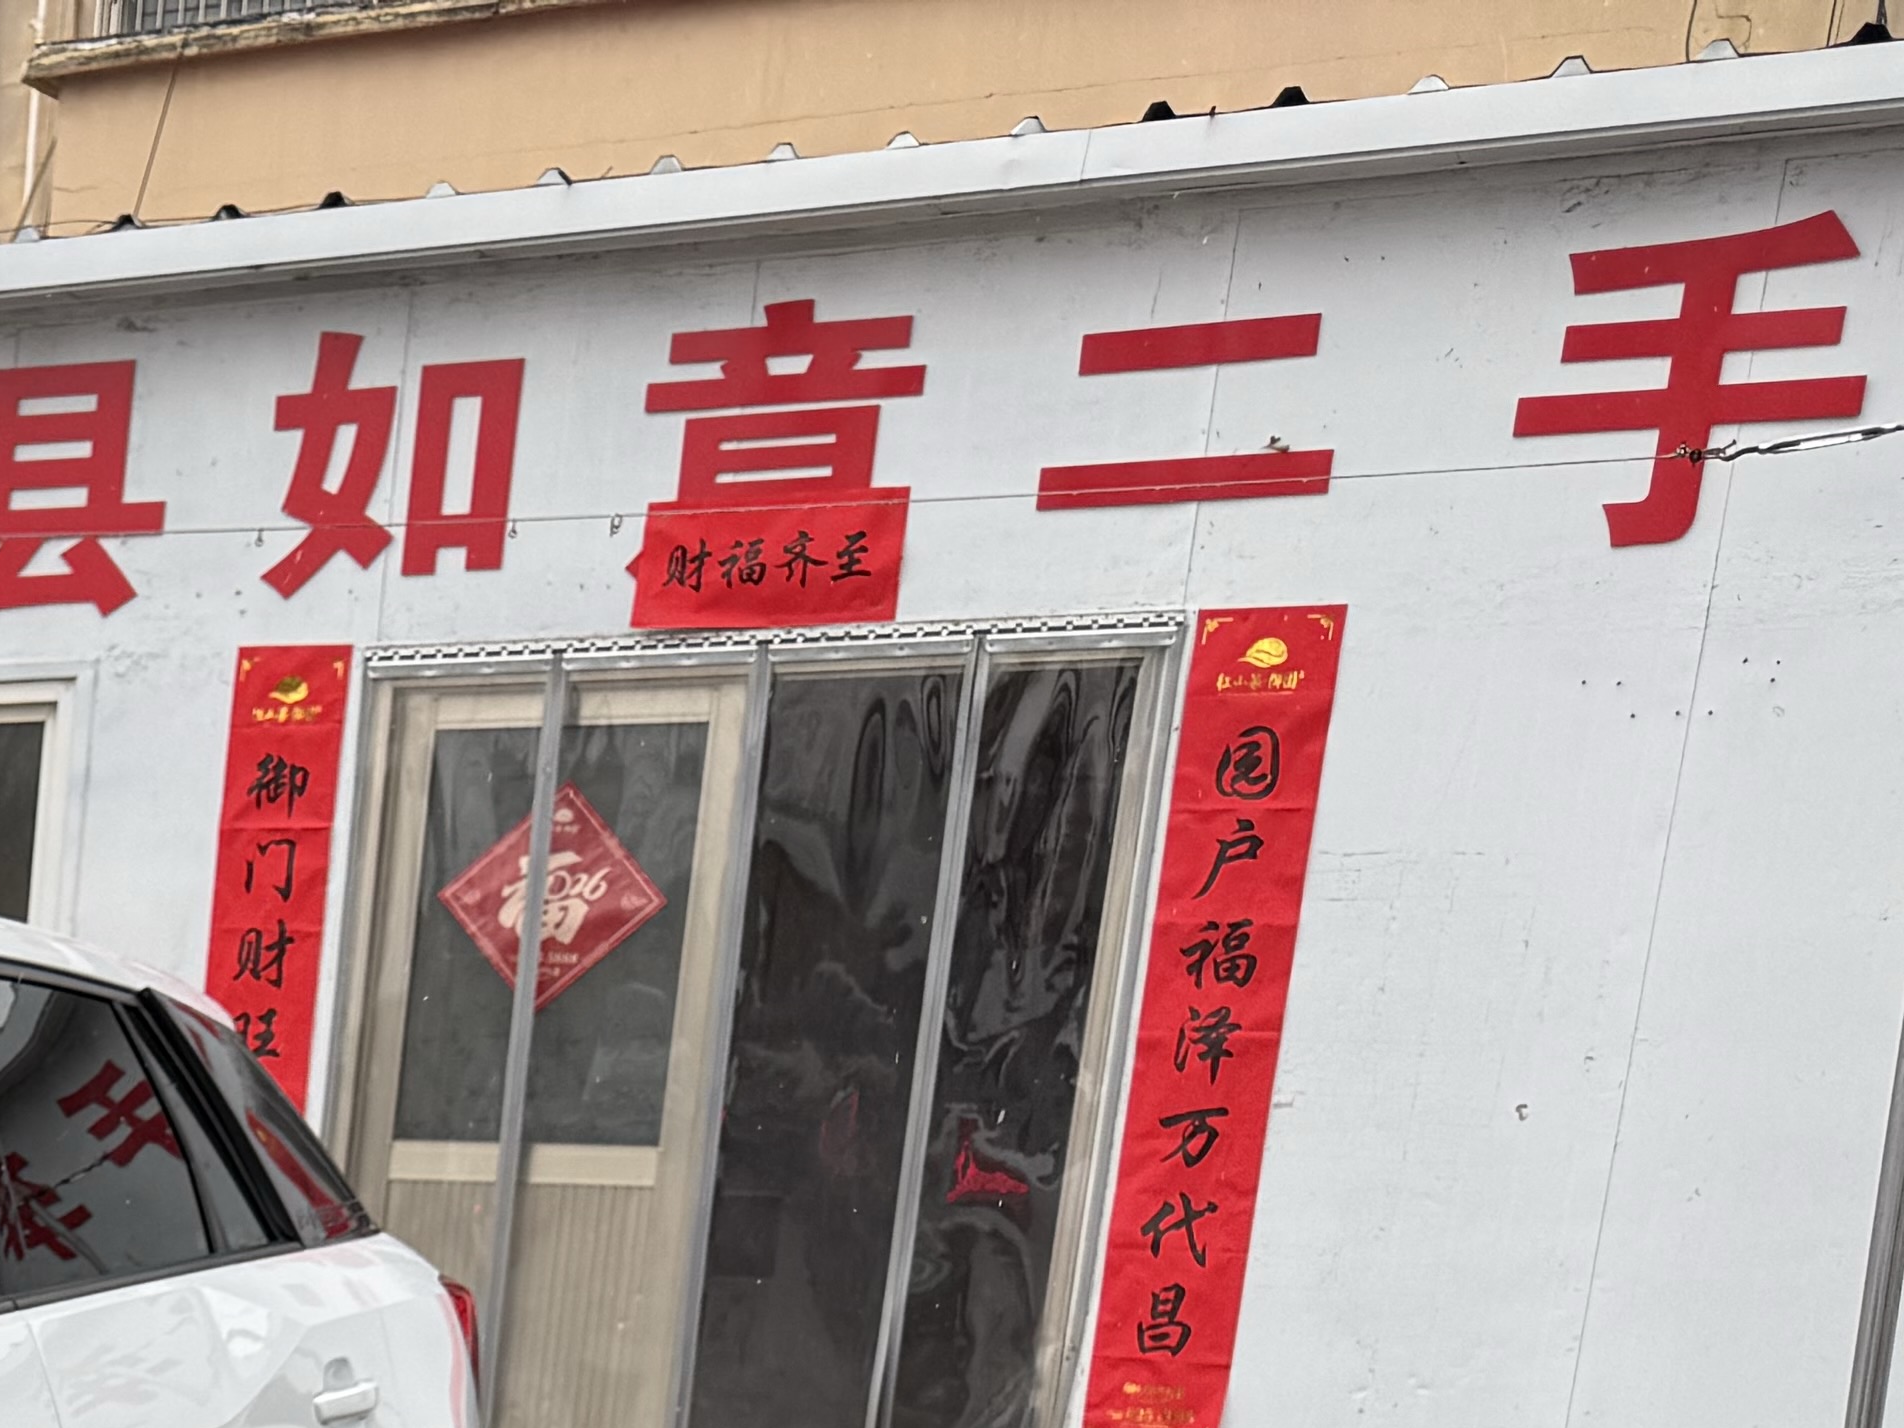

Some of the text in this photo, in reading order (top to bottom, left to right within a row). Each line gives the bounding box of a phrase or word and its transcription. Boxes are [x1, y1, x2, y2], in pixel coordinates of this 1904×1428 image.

[661, 530, 873, 593] 财福齐至
[1136, 724, 1281, 1358] 园户福泽万代昌
